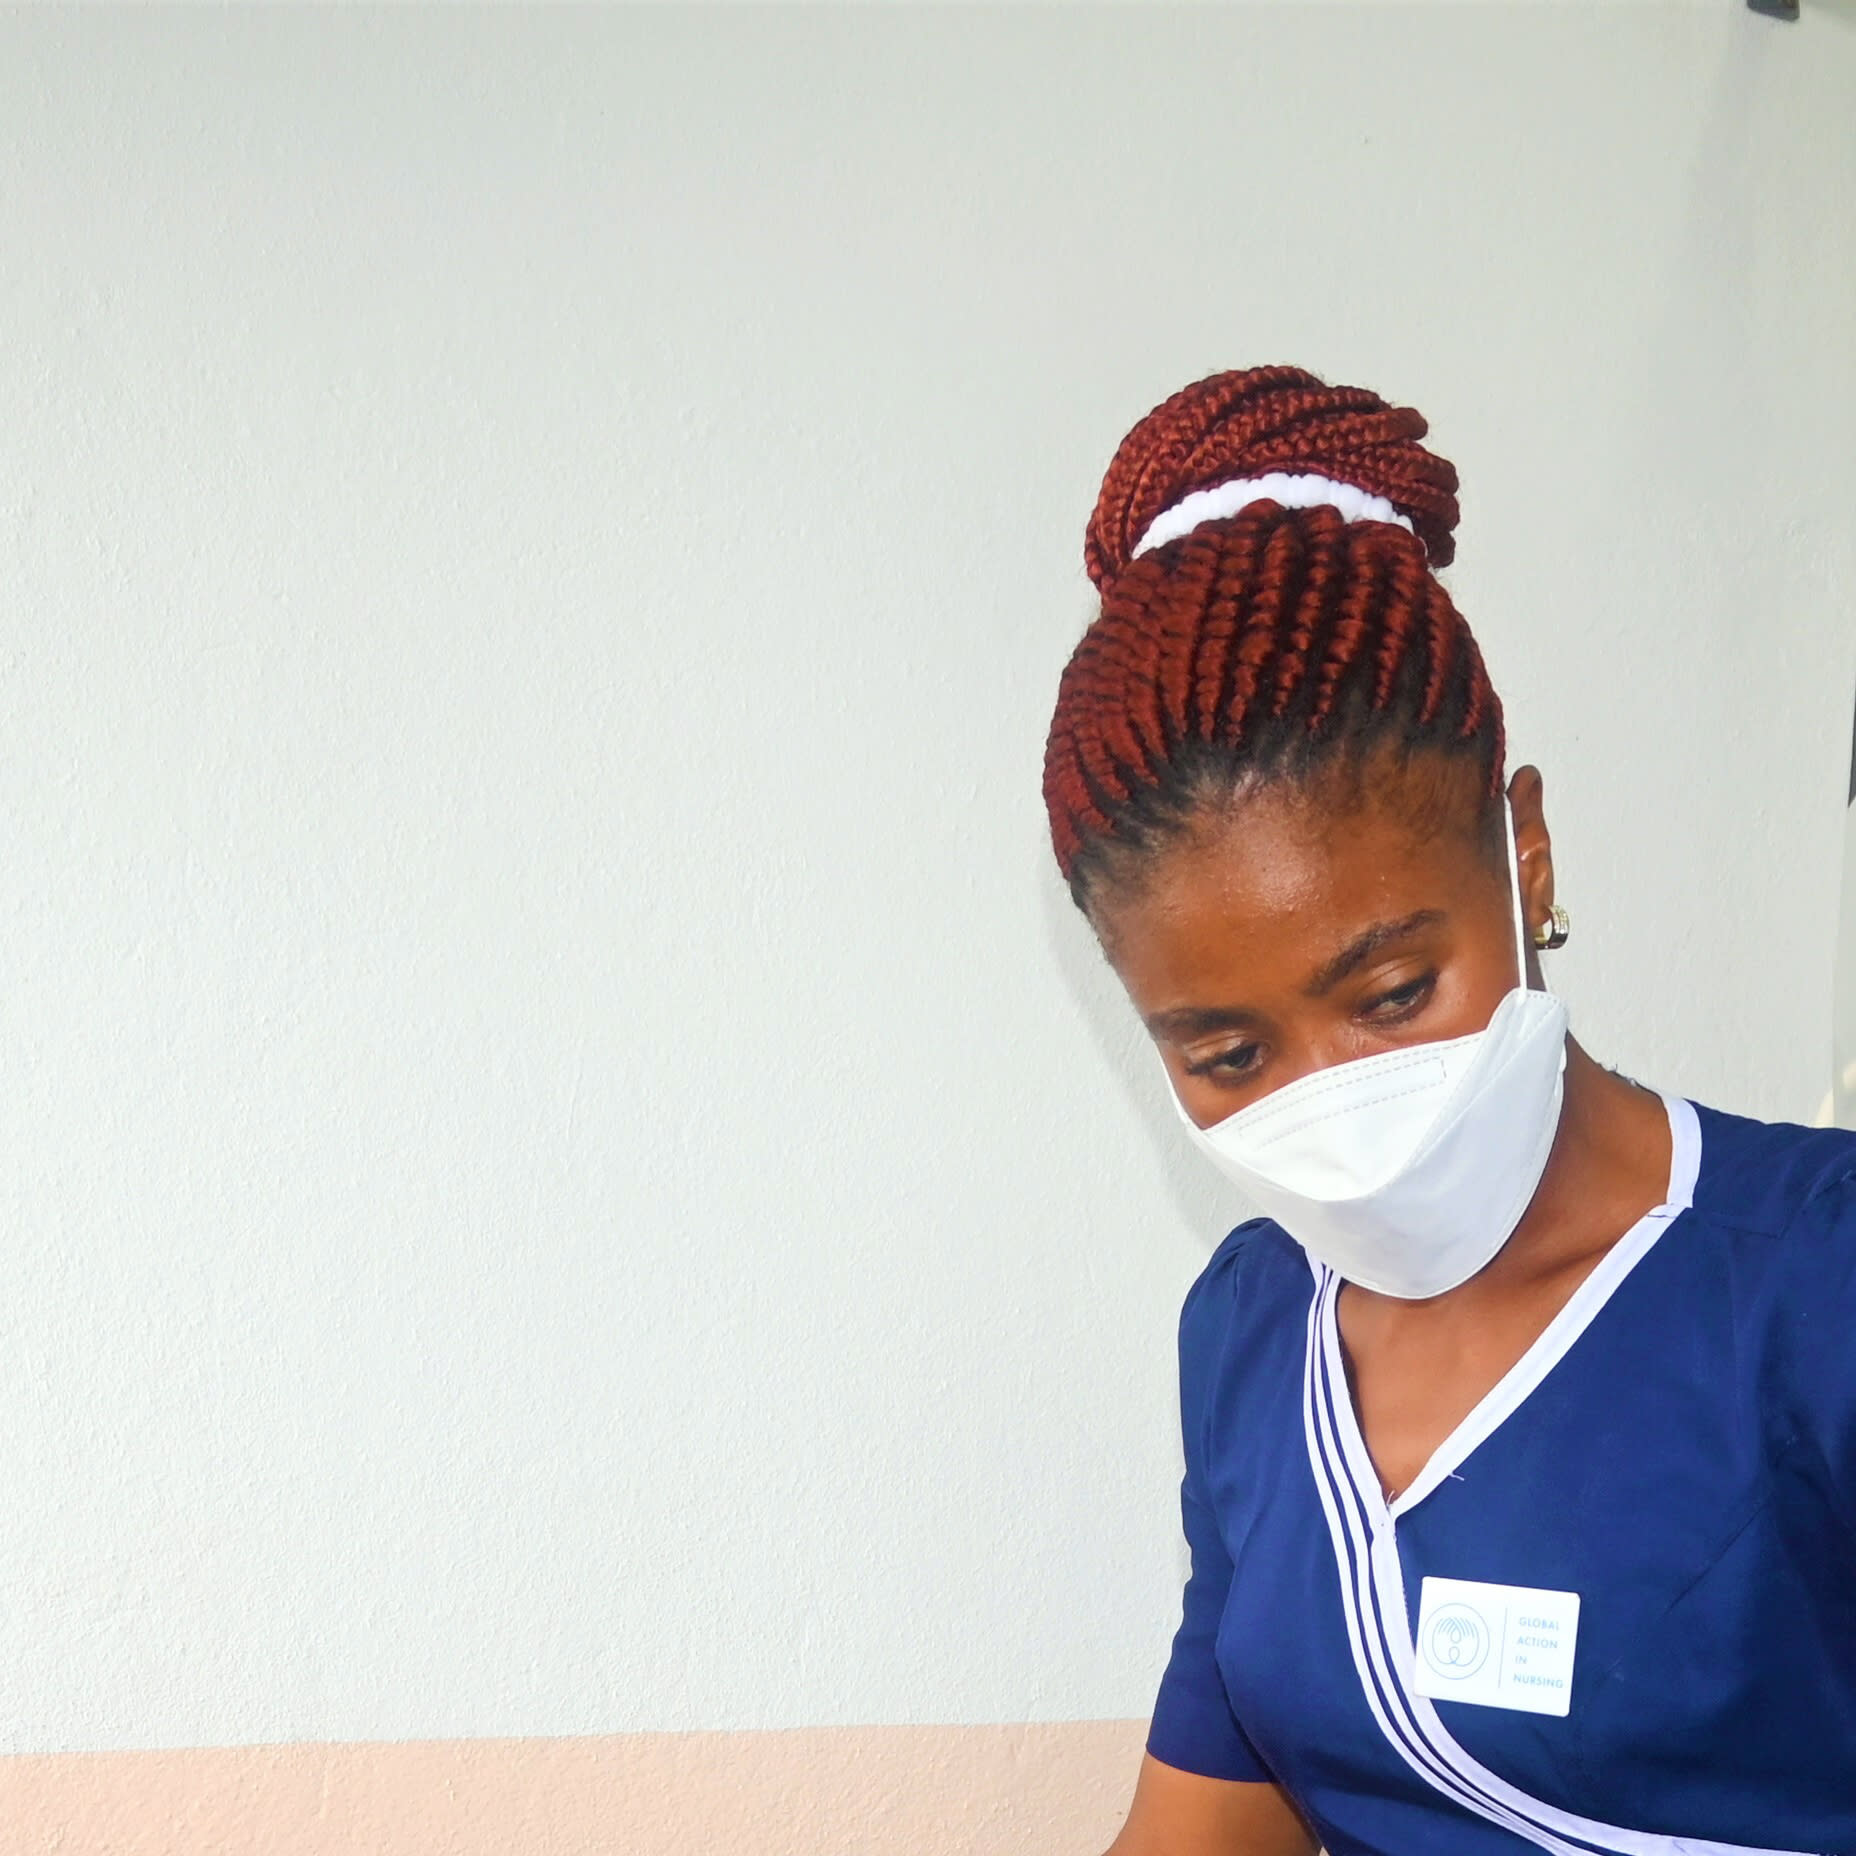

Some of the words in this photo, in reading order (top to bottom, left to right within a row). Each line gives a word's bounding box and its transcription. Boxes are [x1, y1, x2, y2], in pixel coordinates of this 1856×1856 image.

[1518, 1617, 1559, 1631] GLOBAL
[1516, 1636, 1558, 1649] ACTION
[1515, 1655, 1528, 1665] IN
[1513, 1673, 1564, 1689] NURSING
